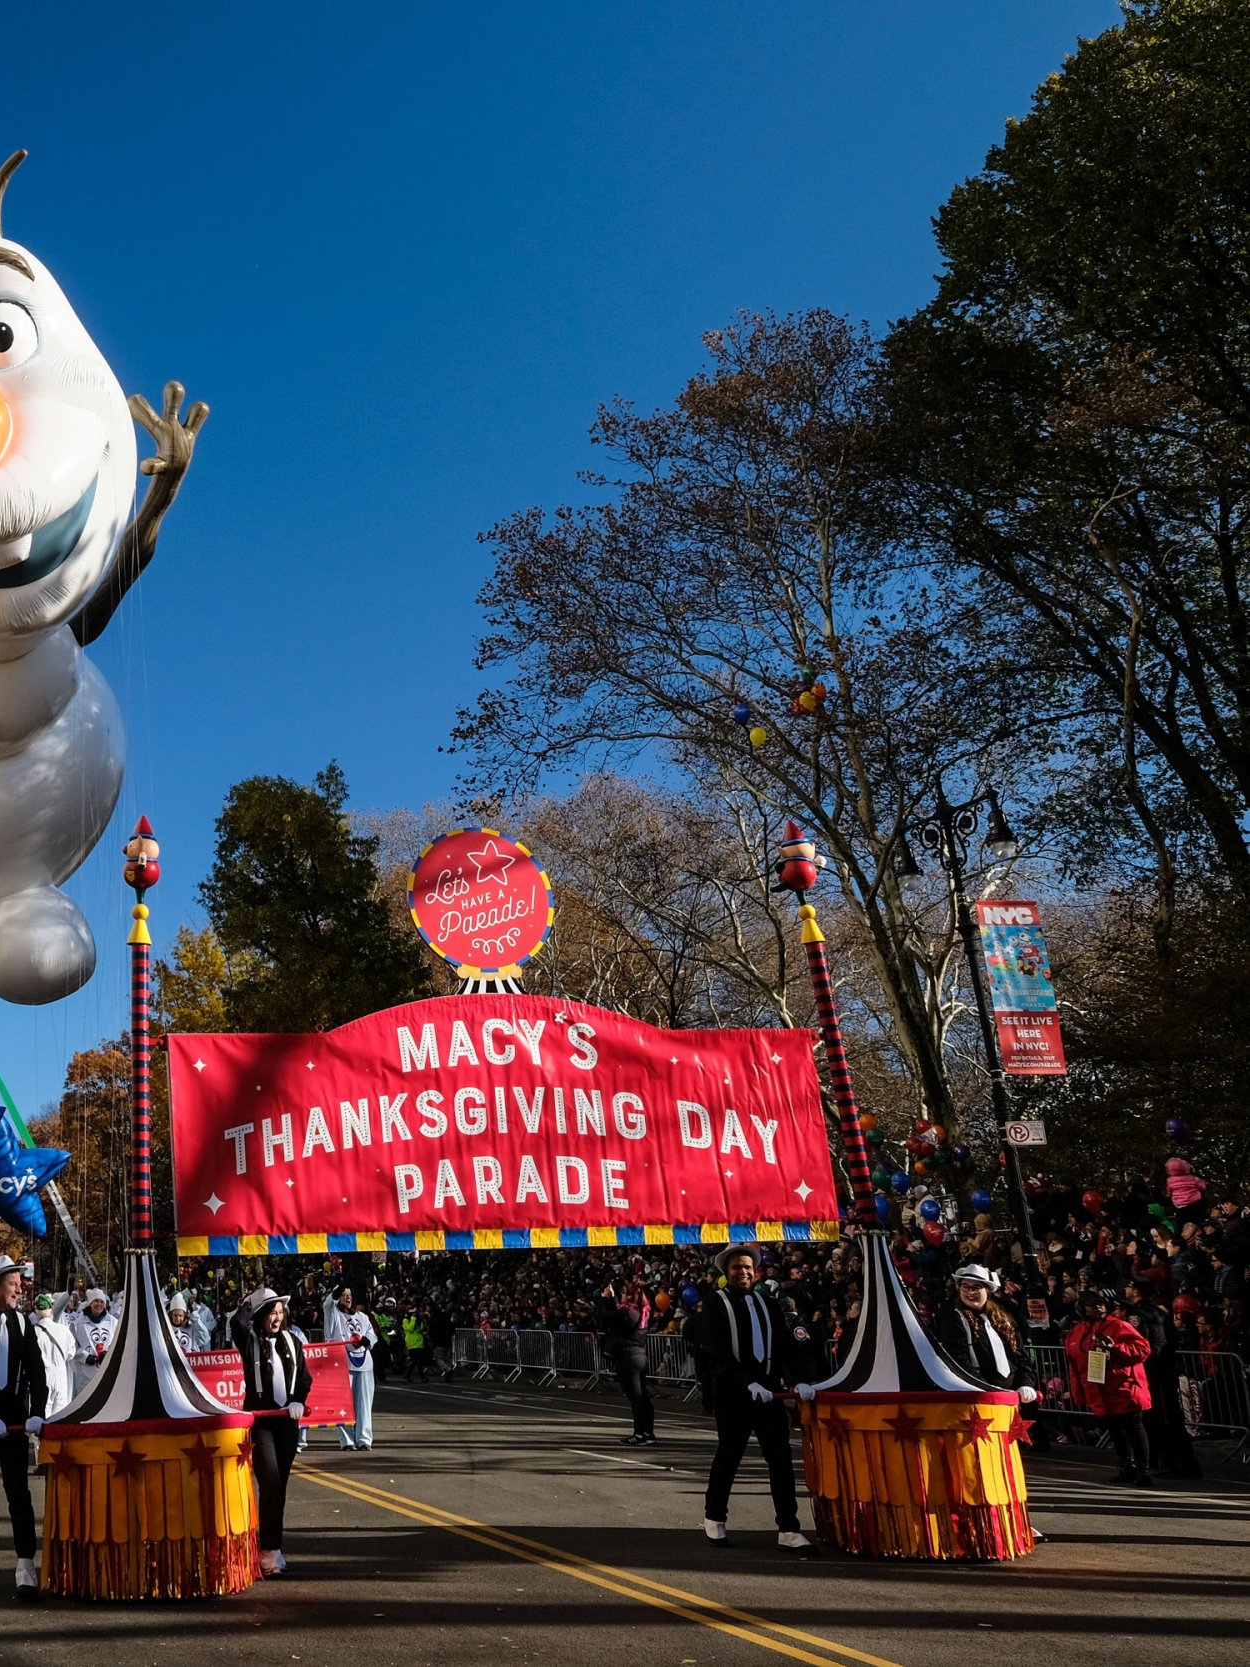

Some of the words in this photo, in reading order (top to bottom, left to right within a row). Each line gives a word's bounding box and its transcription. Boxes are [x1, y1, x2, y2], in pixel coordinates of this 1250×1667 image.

[425, 867, 470, 904] Let's
[461, 892, 492, 911] HAVE
[497, 888, 505, 900] A
[437, 884, 536, 942] Parade!
[982, 906, 1034, 925] NYC
[1001, 1016, 1019, 1025] SEE
[1020, 1016, 1029, 1025] IT
[1031, 1017, 1053, 1025] LIVE
[1016, 1029, 1042, 1038] HERE
[1013, 1042, 1025, 1051] IN
[1026, 1042, 1049, 1051] NYC!
[224, 1086, 646, 1175] THANKSGIVING
[676, 1099, 778, 1164] DAY
[394, 1155, 629, 1214] PARADE
